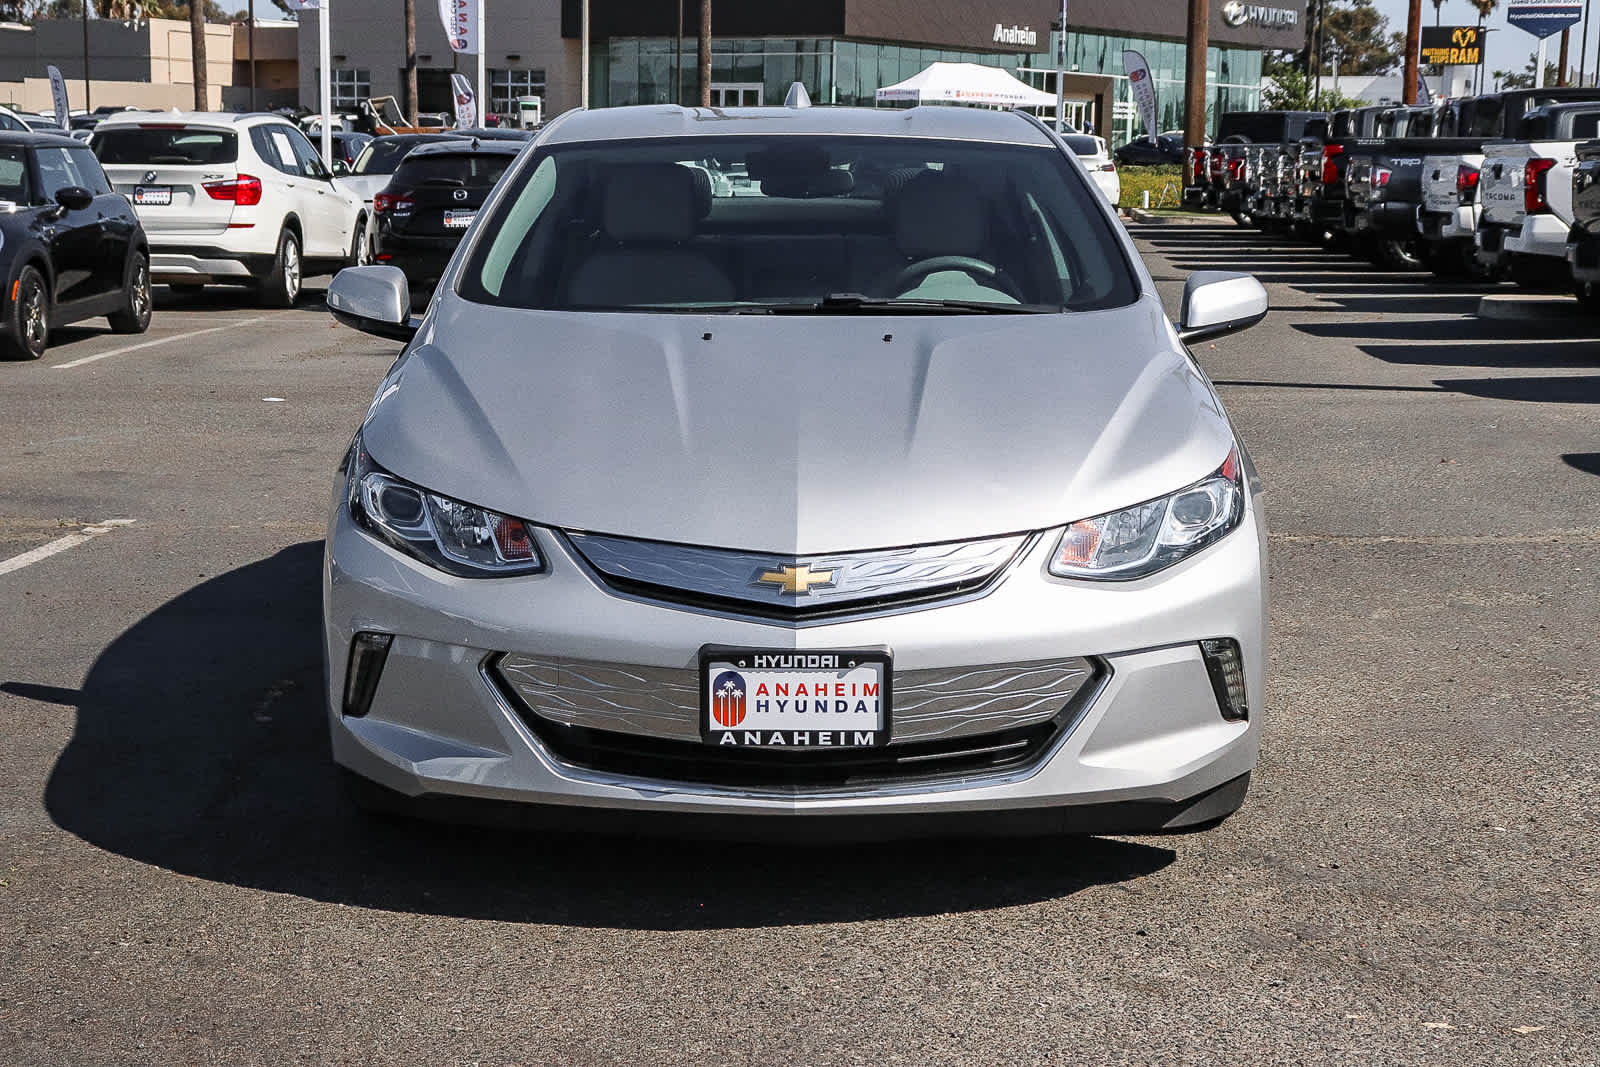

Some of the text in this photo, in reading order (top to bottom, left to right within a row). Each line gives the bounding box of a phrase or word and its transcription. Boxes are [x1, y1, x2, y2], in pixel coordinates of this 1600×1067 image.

[1249, 5, 1298, 24] HYUNDAI
[993, 23, 1037, 46] Anaheim
[1450, 48, 1479, 64] RAM
[1391, 158, 1421, 166] TRD
[1485, 192, 1516, 201] TACOMA
[754, 655, 839, 668] HYUNDAI
[755, 683, 880, 697] ANAHEIM
[755, 700, 880, 713] HYUNDAI
[719, 731, 874, 745] ANAHEIM
